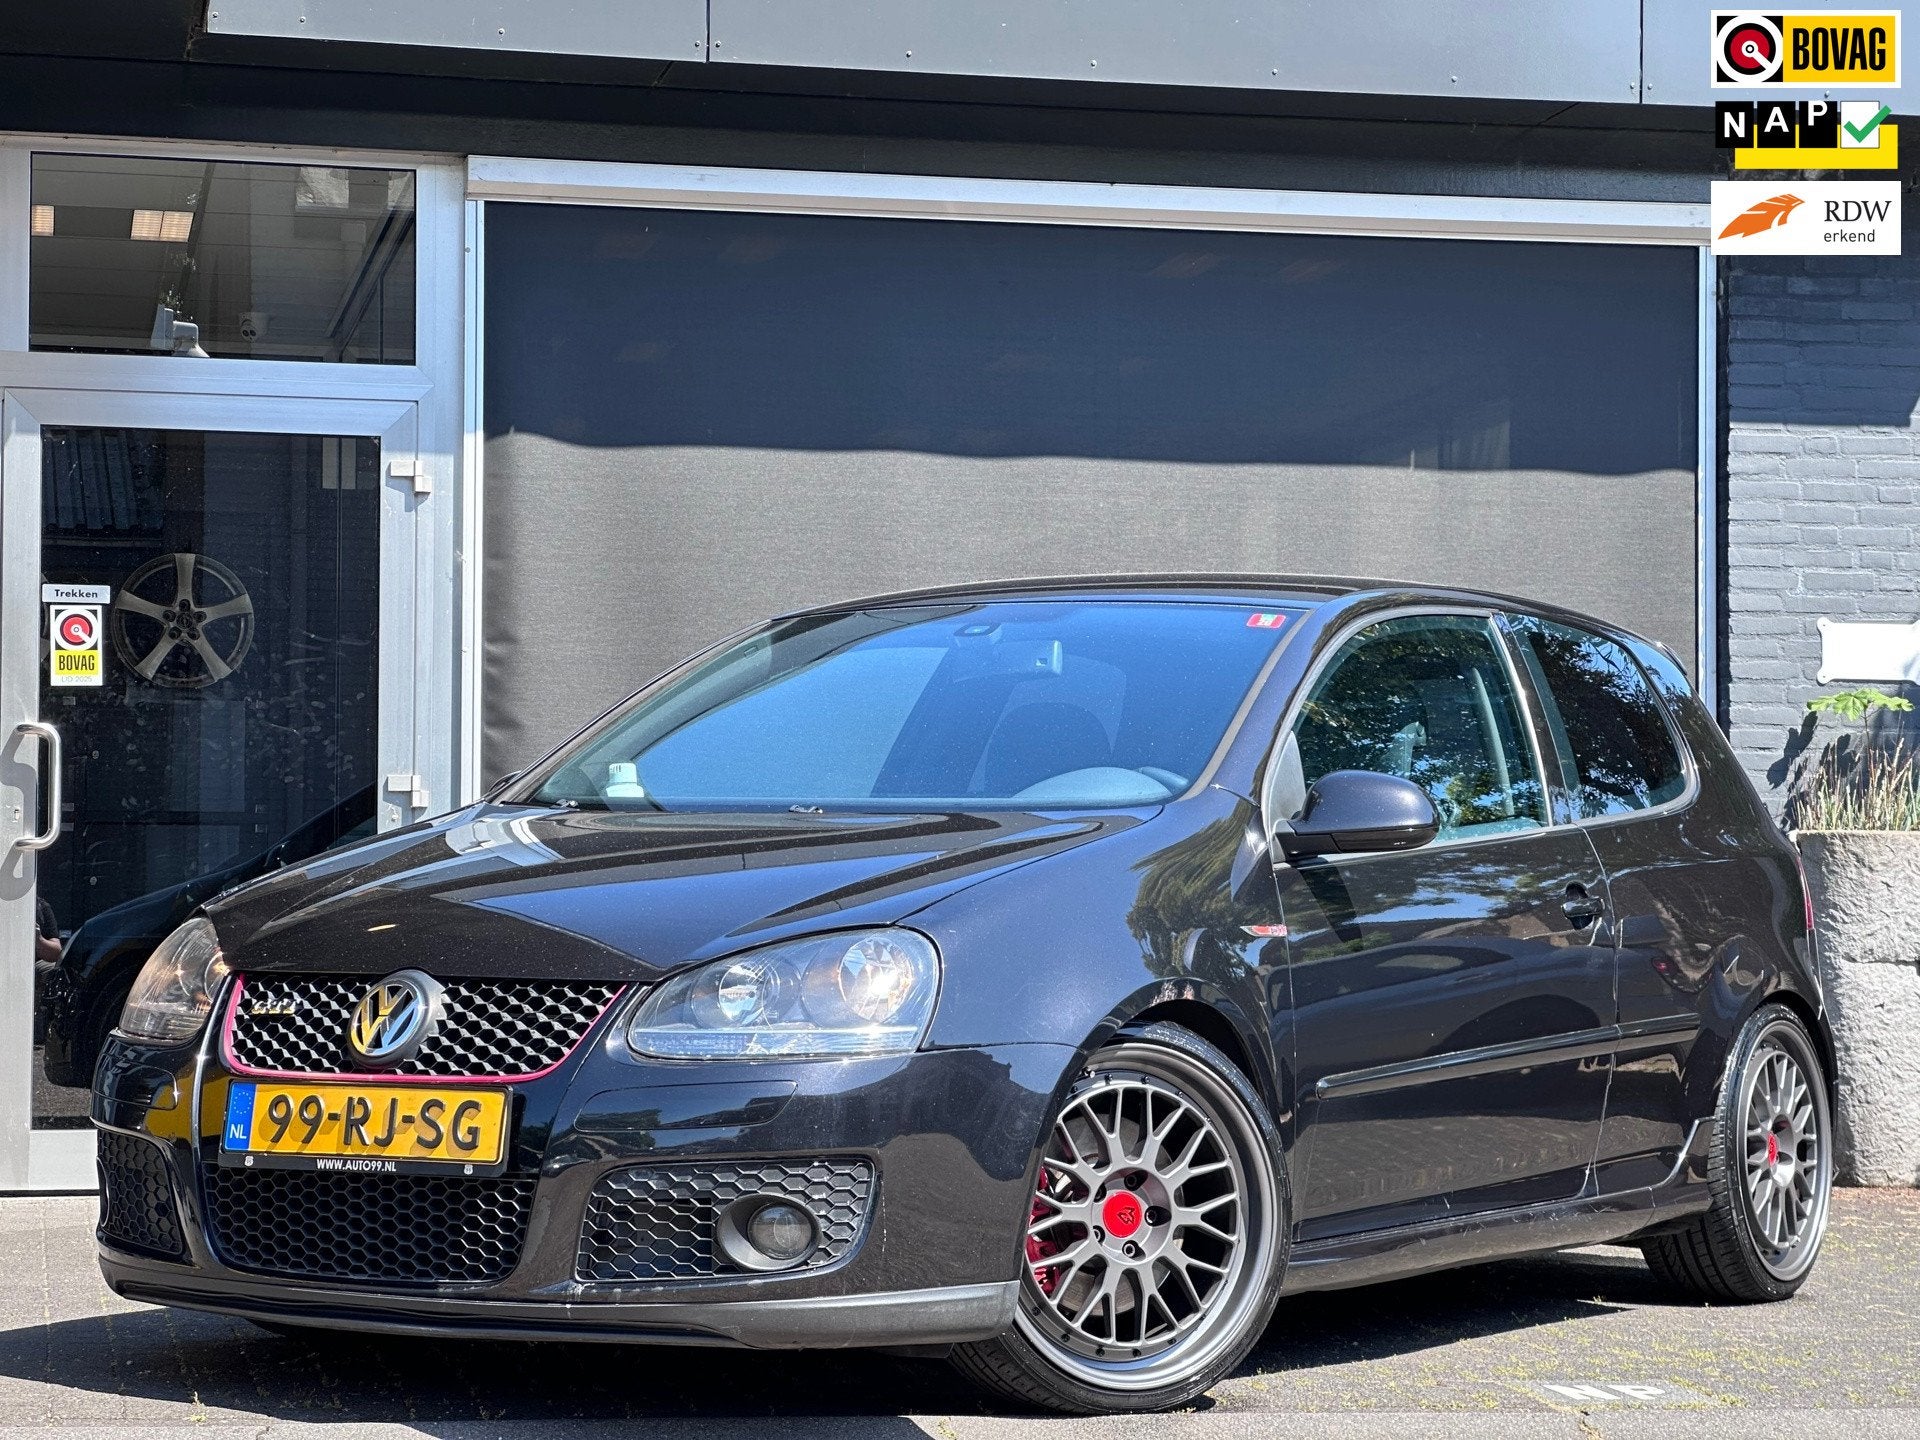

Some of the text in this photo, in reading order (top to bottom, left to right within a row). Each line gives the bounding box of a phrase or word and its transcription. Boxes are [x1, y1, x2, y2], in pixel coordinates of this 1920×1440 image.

[54, 588, 99, 599] Trekken
[58, 654, 96, 671] BOVAG
[268, 1093, 482, 1151] 99-RJ-SG
[229, 1122, 247, 1140] NL
[316, 1158, 397, 1173] WWW.AUTO99.NL
